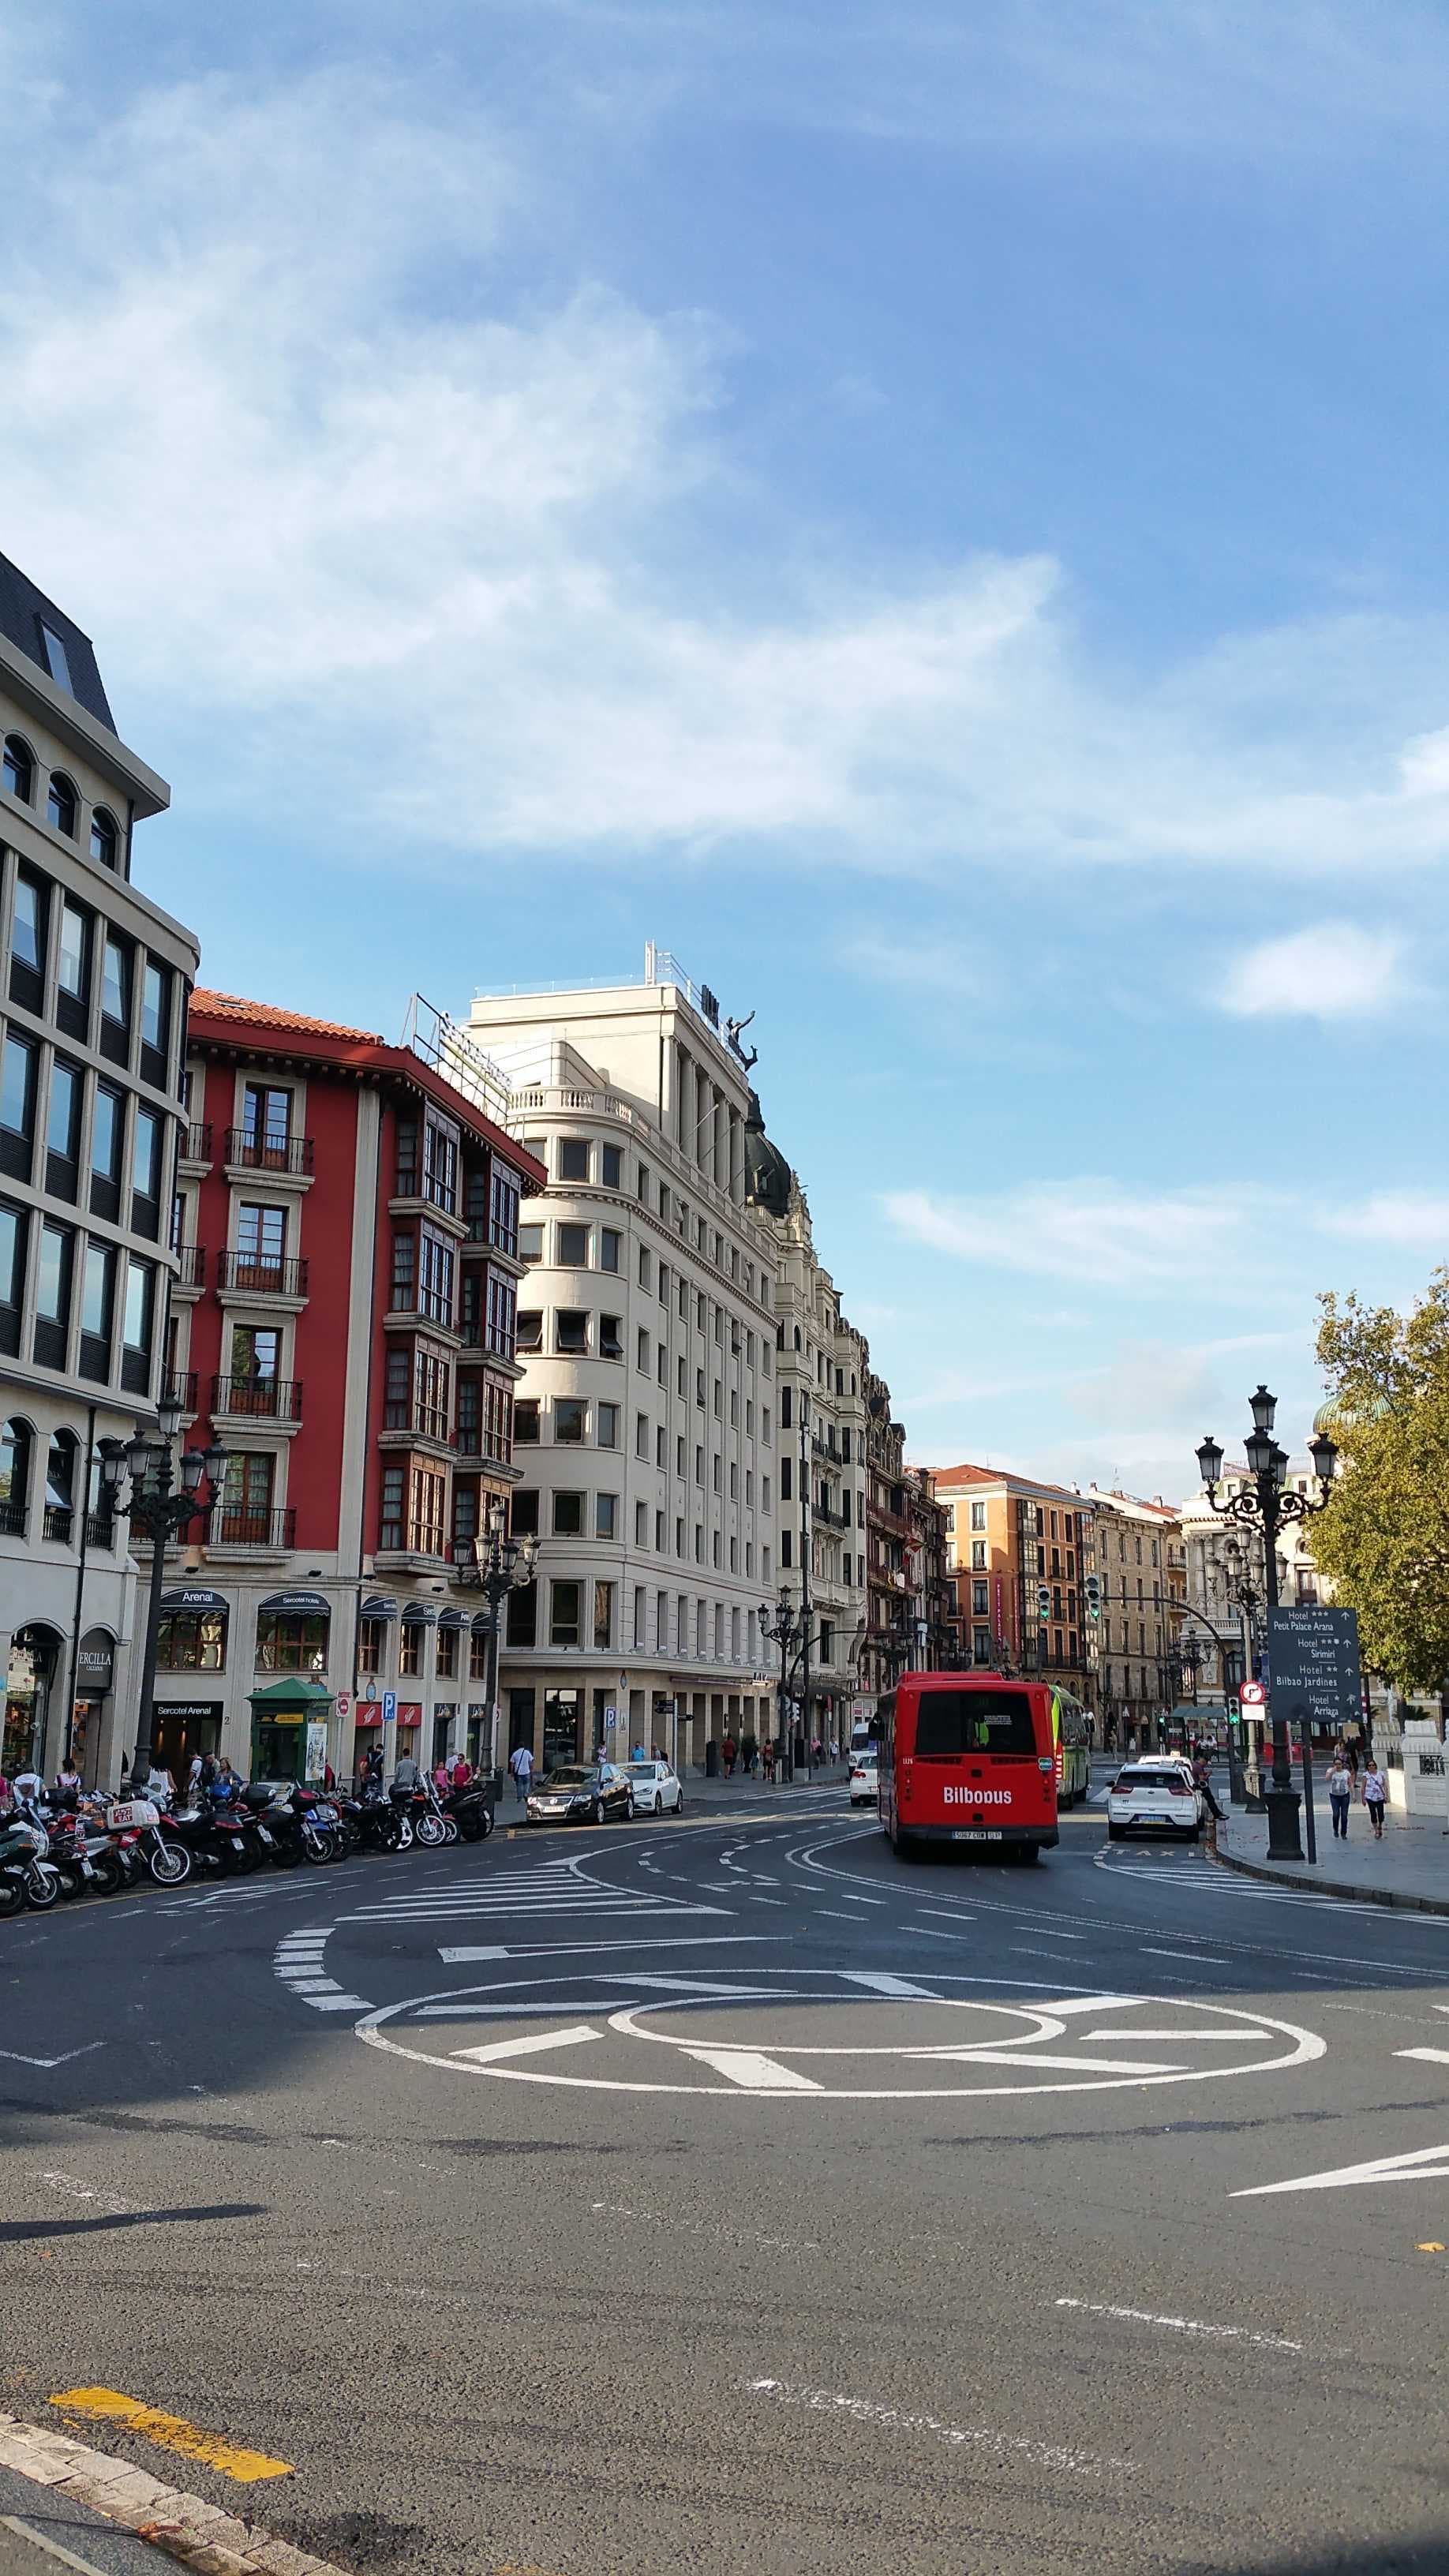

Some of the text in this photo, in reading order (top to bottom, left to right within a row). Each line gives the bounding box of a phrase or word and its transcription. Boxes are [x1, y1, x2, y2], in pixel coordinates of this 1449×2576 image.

[182, 1593, 214, 1602] Arenal
[1288, 1611, 1309, 1620] Hotel
[1274, 1621, 1334, 1631] Petit Palace Arana
[1297, 1638, 1318, 1648] Hotel
[79, 1652, 111, 1665] ERCILLA
[1311, 1649, 1335, 1658] Sirimiri
[1299, 1665, 1323, 1674] Hotel
[1276, 1676, 1338, 1688] Bilbao Jardines
[1309, 1694, 1329, 1705] Hotel
[1314, 1706, 1339, 1718] Arriaga
